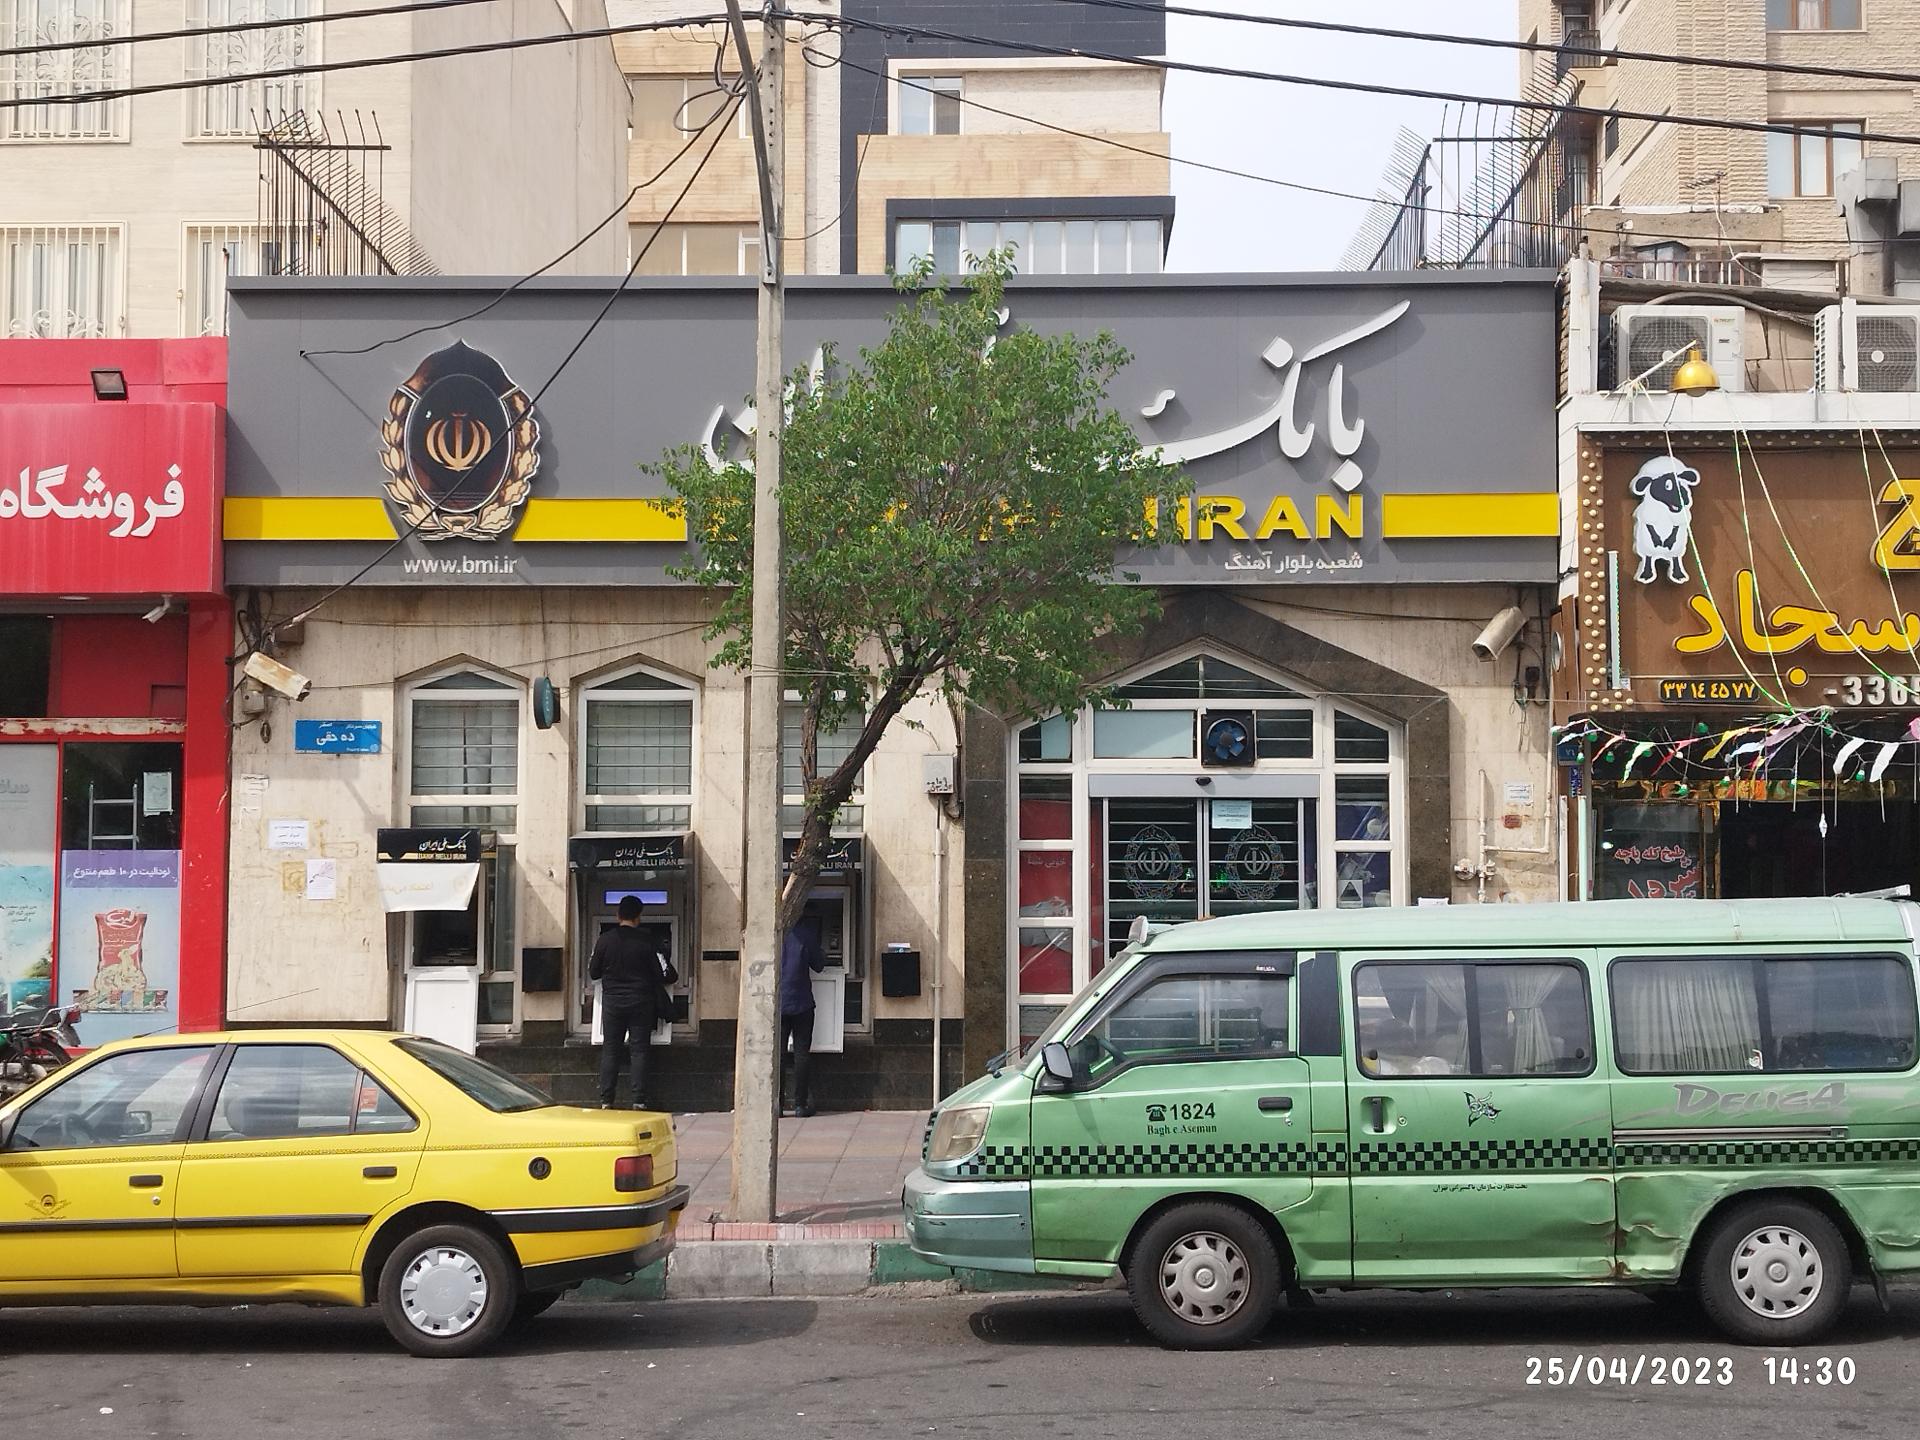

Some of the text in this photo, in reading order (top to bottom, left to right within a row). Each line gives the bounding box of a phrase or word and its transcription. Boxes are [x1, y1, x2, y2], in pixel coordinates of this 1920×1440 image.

[0, 464, 185, 537] فروشگاه
[1177, 494, 1364, 540] IRAN
[403, 555, 518, 574] www.bmi.ir
[1224, 550, 1363, 574] شعبه بلوار آهنگ
[1675, 569, 1920, 687] سجاد
[613, 859, 634, 867] BANK
[635, 859, 658, 867] MELLI
[1170, 1102, 1216, 1121] 1824
[1147, 1124, 1171, 1137] Bagh
